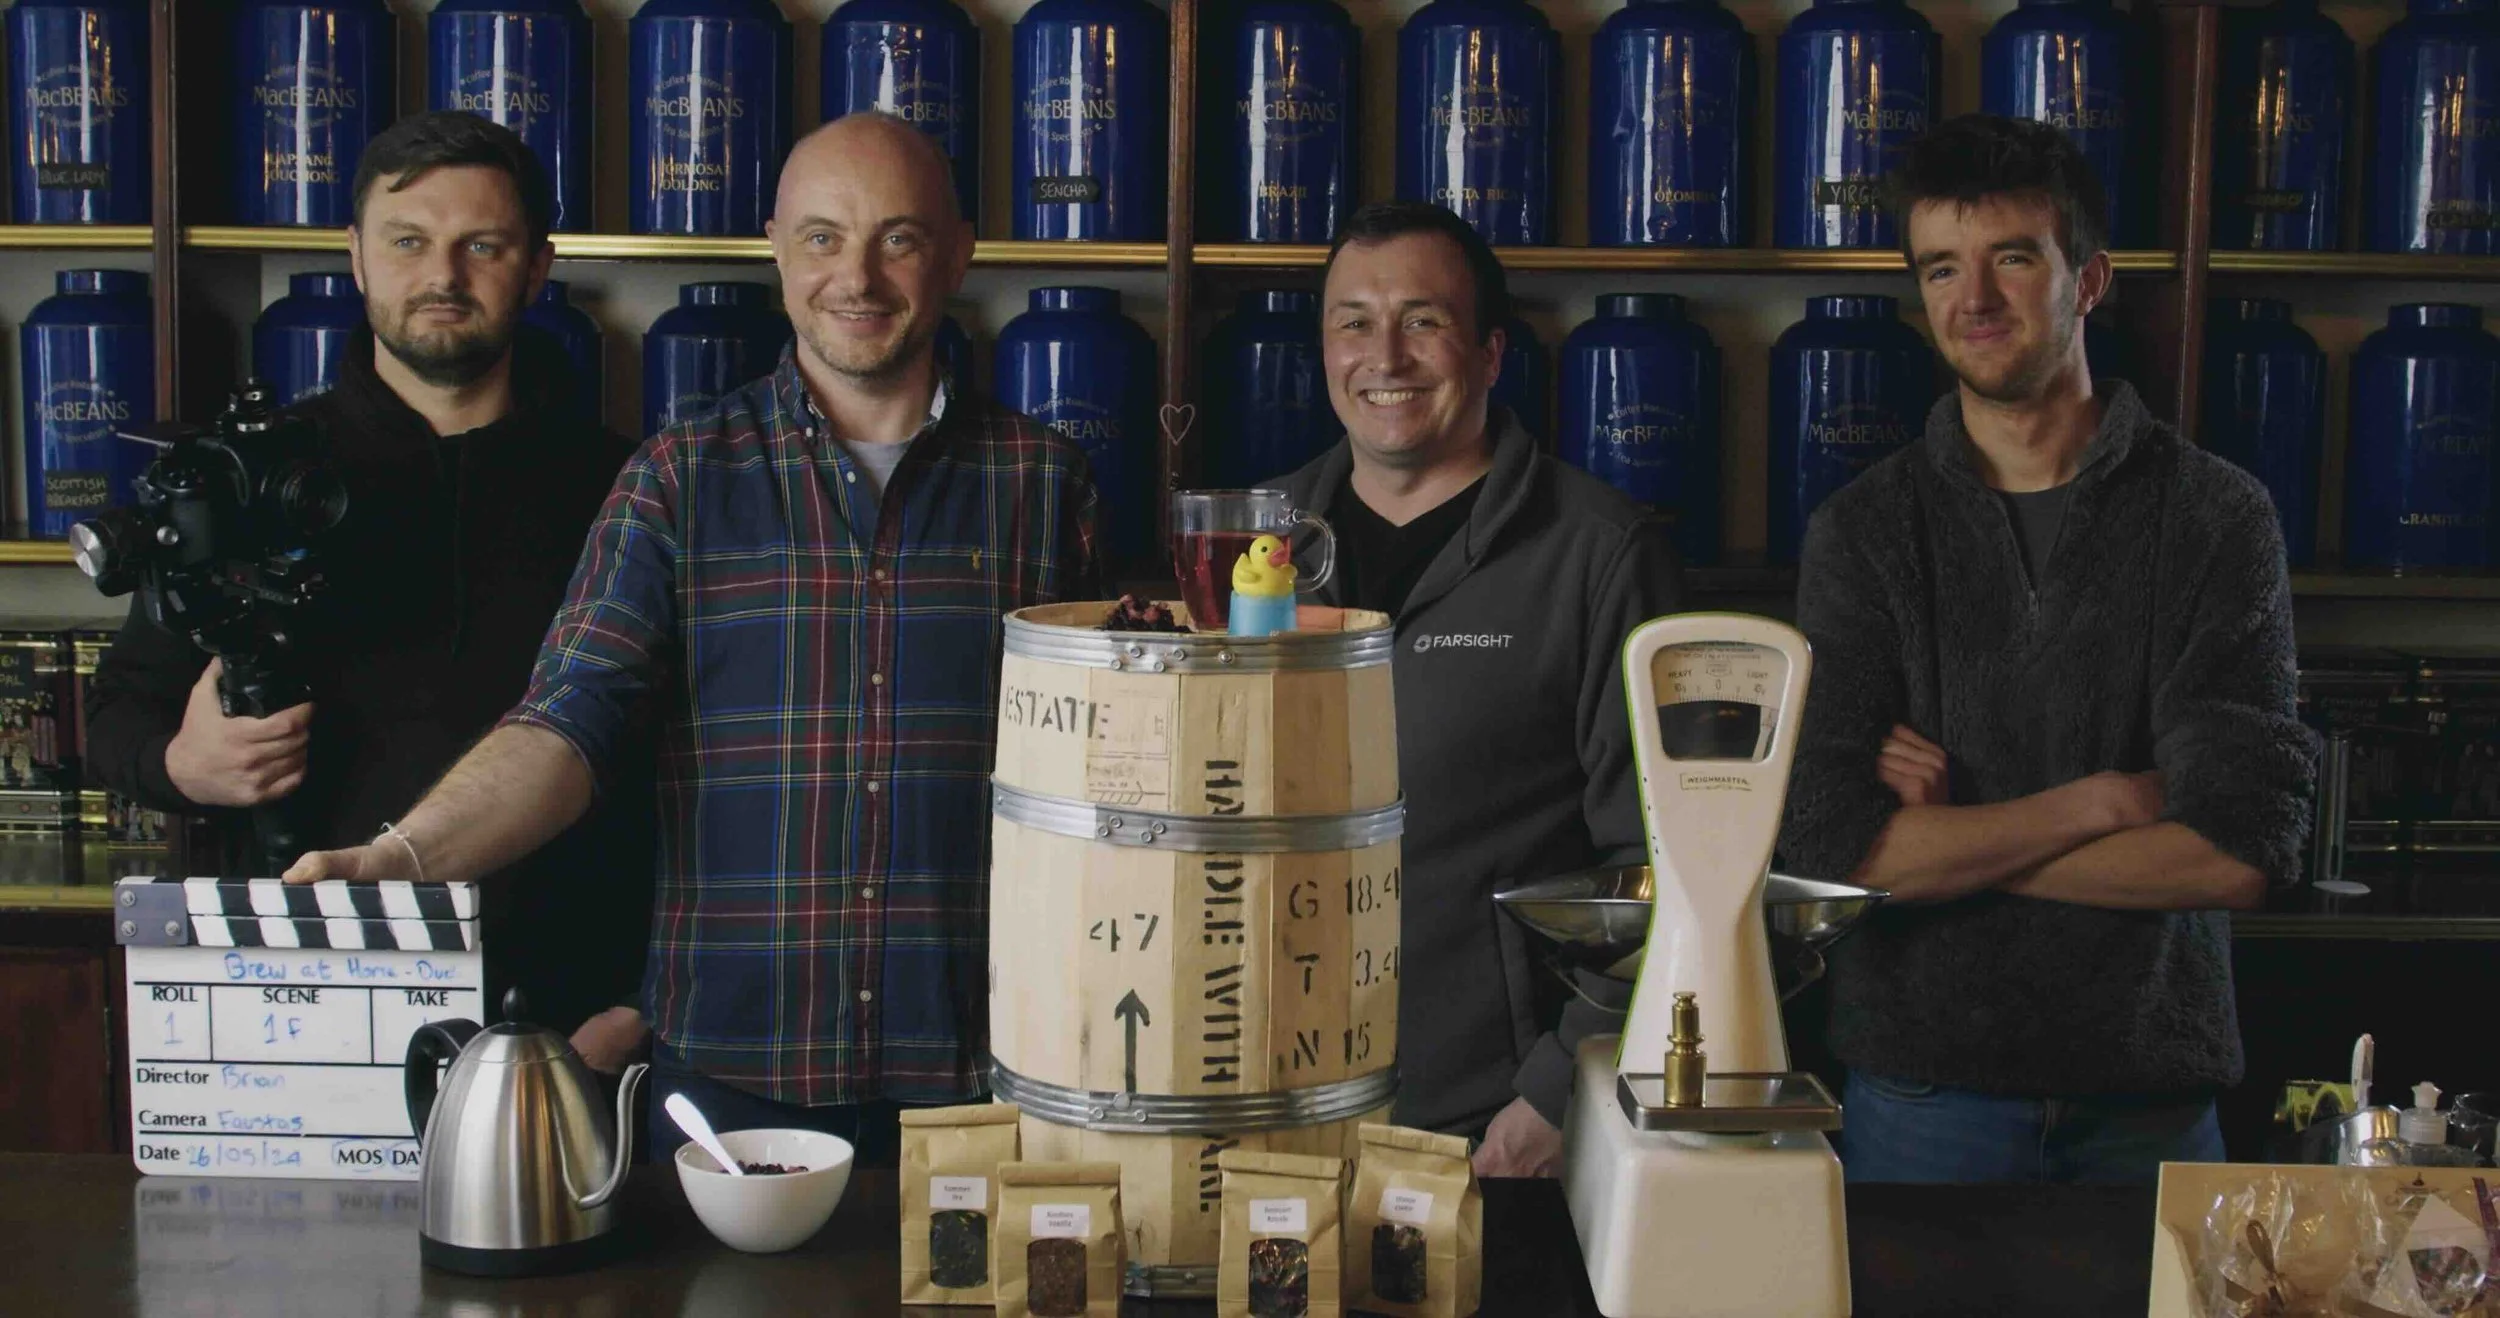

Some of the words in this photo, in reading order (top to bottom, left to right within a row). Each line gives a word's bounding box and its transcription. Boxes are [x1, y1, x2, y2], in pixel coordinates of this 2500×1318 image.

[450, 90, 552, 114] MacBANS
[646, 97, 745, 119] MacBANS
[1236, 100, 1337, 123] McBEANS
[268, 153, 333, 167] LAPANG
[265, 169, 340, 184] OUCONG
[1040, 181, 1088, 198] SENCHA
[1436, 188, 1480, 201] COTA
[1433, 634, 1513, 649] FARSIGHT
[1006, 686, 1111, 739] ESTATE
[1205, 760, 1245, 945] HADLE
[1288, 880, 1318, 919] G
[1345, 867, 1400, 916] 18.4
[1089, 913, 1159, 952] 47
[224, 952, 286, 980] Brew
[300, 959, 333, 980] at
[346, 956, 398, 980] Home
[1294, 953, 1320, 995] T
[152, 986, 198, 1003] ROLL
[262, 987, 321, 1005] SCENE
[405, 990, 449, 1007] TAKE
[164, 1011, 183, 1045] 1
[1202, 964, 1245, 1083] WITH
[1343, 1021, 1371, 1065] 15
[136, 1065, 210, 1086] Director
[221, 1064, 286, 1090] Brian
[138, 1109, 207, 1128] Camera
[139, 1144, 181, 1161] Date
[337, 1150, 383, 1166] MOS
